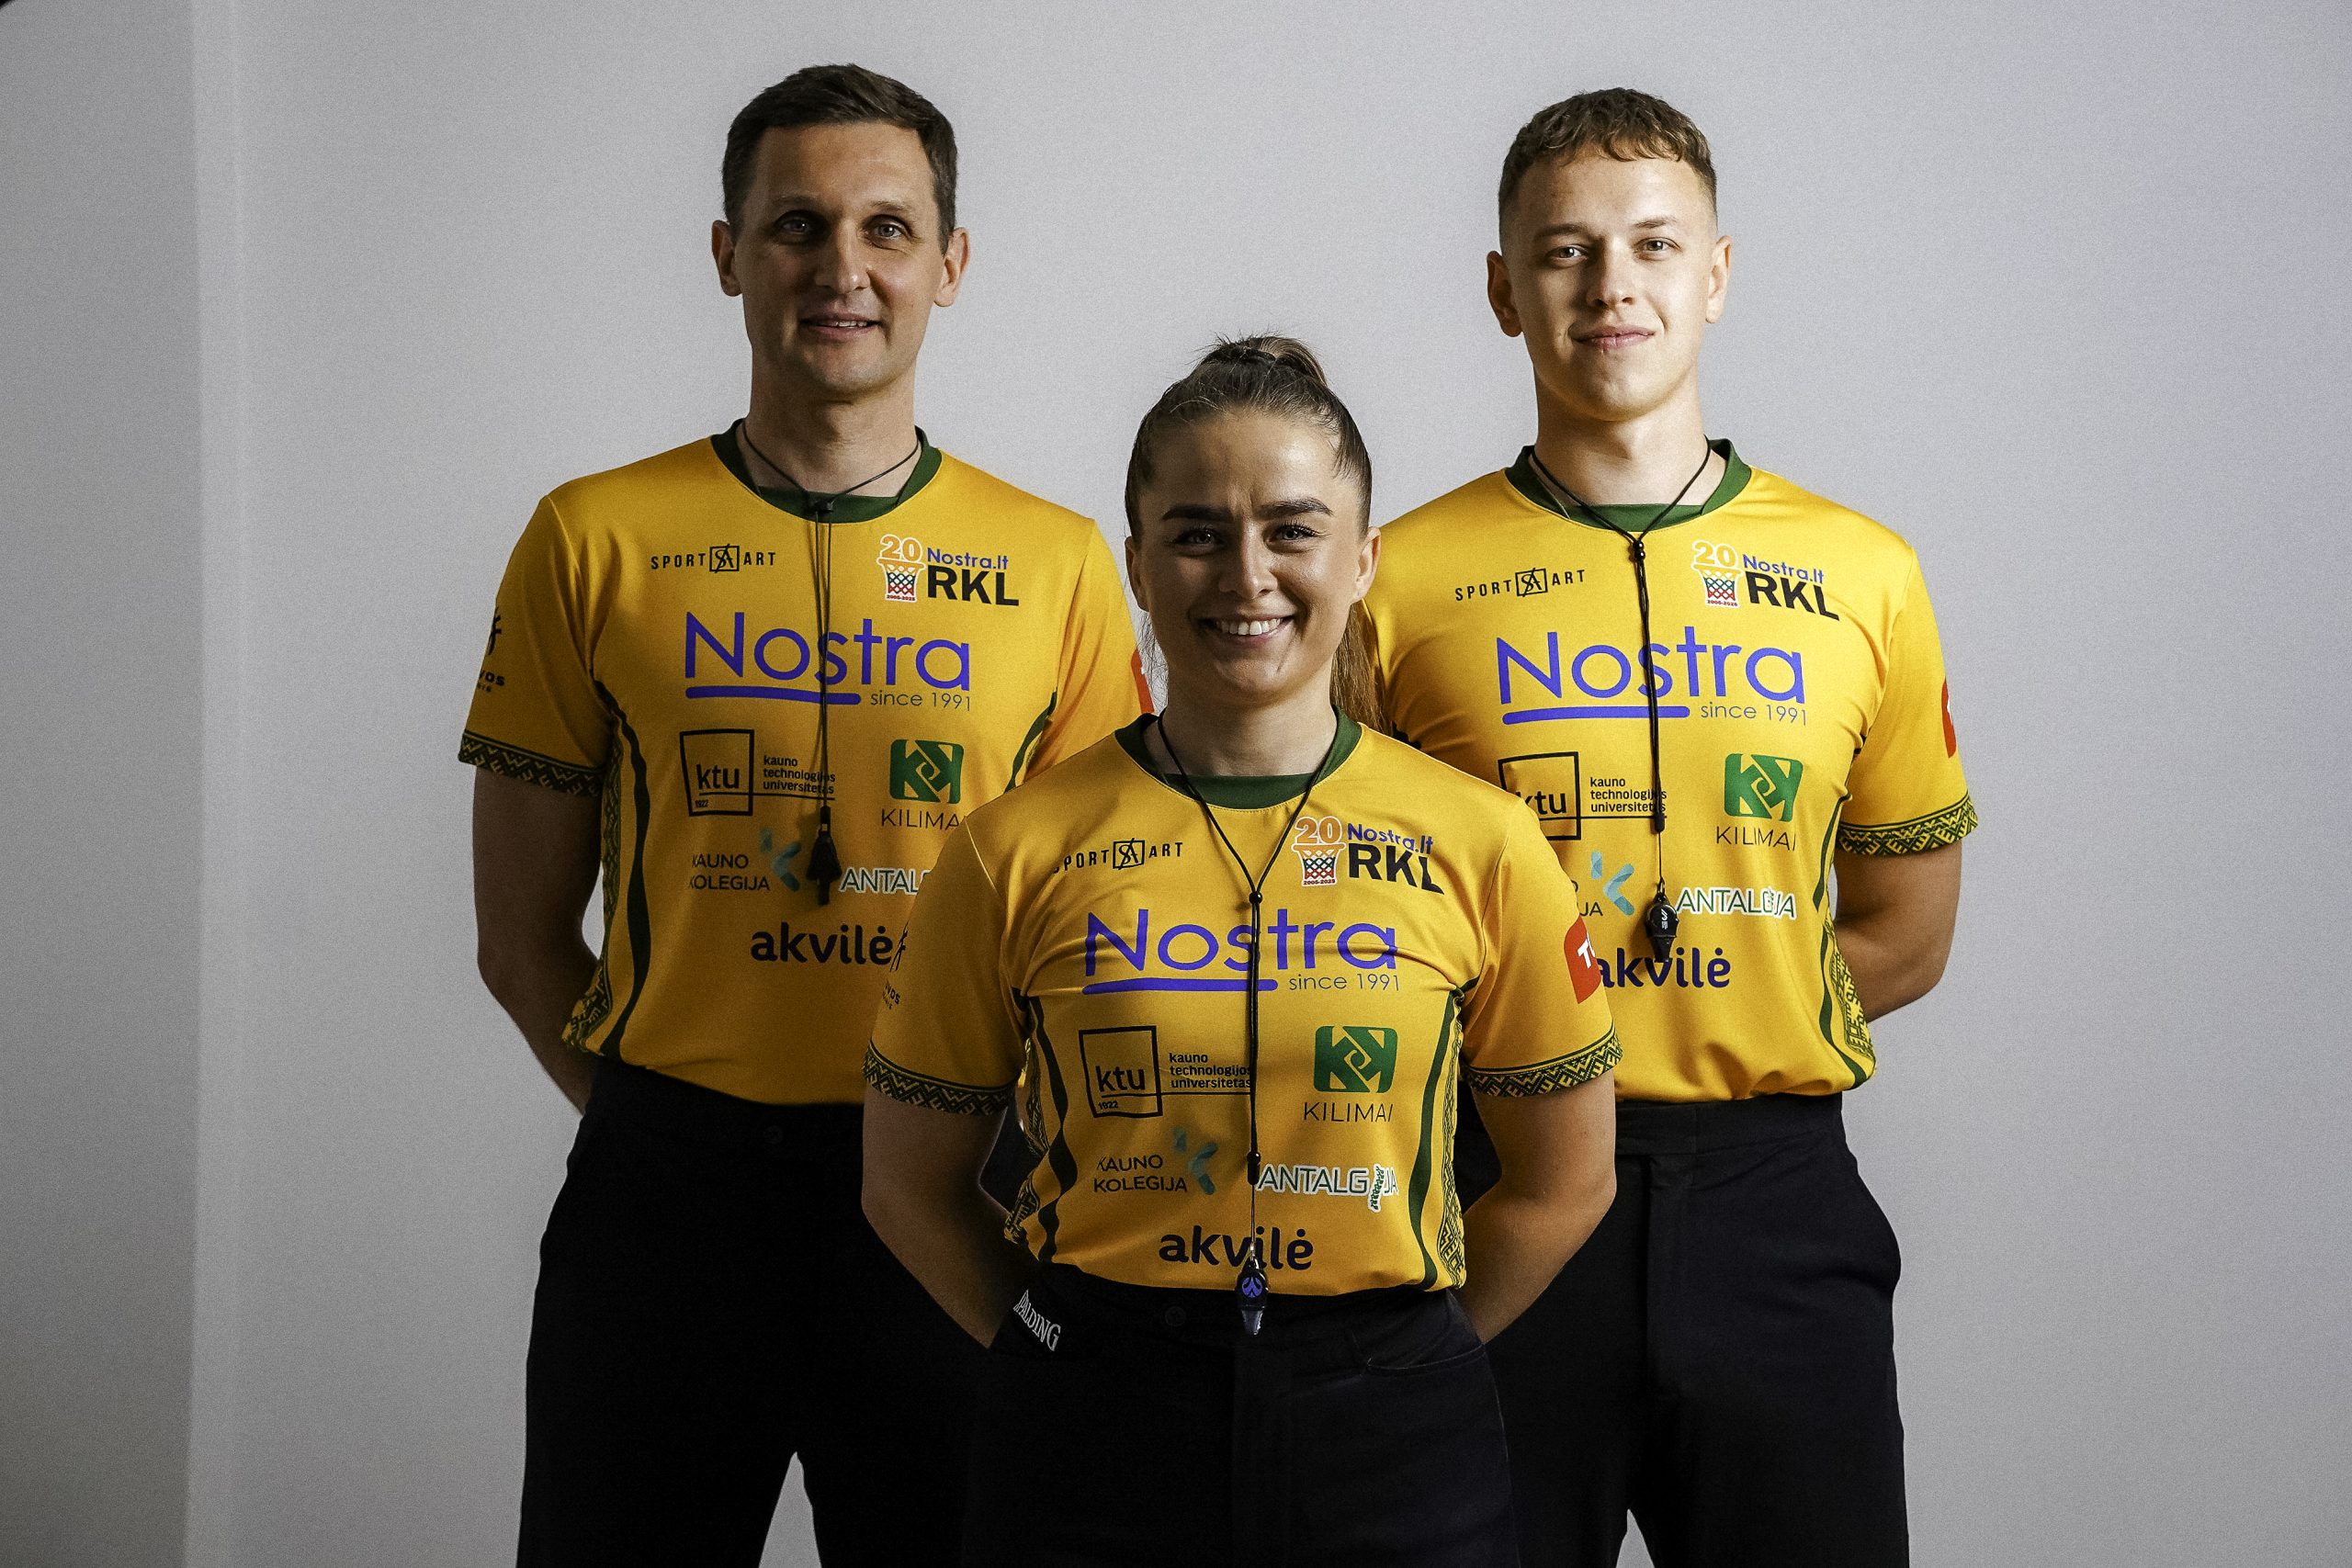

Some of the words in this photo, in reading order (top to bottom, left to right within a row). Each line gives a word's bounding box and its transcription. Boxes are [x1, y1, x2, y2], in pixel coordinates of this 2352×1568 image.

[650, 553, 706, 570] SPORT
[743, 552, 775, 566] ART
[879, 534, 923, 562] 20
[927, 547, 1009, 570] Nostra.lt
[1692, 539, 1738, 568] 20
[1742, 553, 1825, 584] Nostra.lt
[927, 565, 1020, 606] RKL
[1454, 580, 1512, 602] SPORT
[1551, 570, 1586, 586] ART
[1745, 570, 1840, 622] RKL
[684, 611, 971, 691] Nostra
[1496, 626, 1805, 705] Nostra
[870, 690, 922, 706] since
[932, 691, 972, 712] 1991
[1700, 701, 1758, 721] since
[1765, 704, 1808, 727] 1991
[763, 755, 798, 767] kauno
[695, 764, 740, 789] ktu
[1589, 776, 1626, 788] kauno
[1590, 789, 1668, 801] technologijs
[1590, 801, 1667, 813] universitets
[1295, 816, 1342, 844] 20
[1347, 822, 1433, 854] Nostra.lt
[1716, 825, 1797, 852] KILIMAI
[1148, 841, 1183, 858] ART
[840, 867, 932, 895] ANTAL
[1349, 842, 1445, 895] RKL
[751, 921, 893, 964] akvilė
[1084, 908, 1397, 976] Nostra
[1288, 973, 1347, 991] since
[1356, 973, 1400, 991] 1991
[1169, 1052, 1209, 1064] kauno
[1095, 1066, 1147, 1093] ktu
[1303, 1101, 1394, 1122] KILIMAI
[1093, 1175, 1188, 1192] KOLEGIJA
[1158, 1224, 1315, 1270] akvilė
